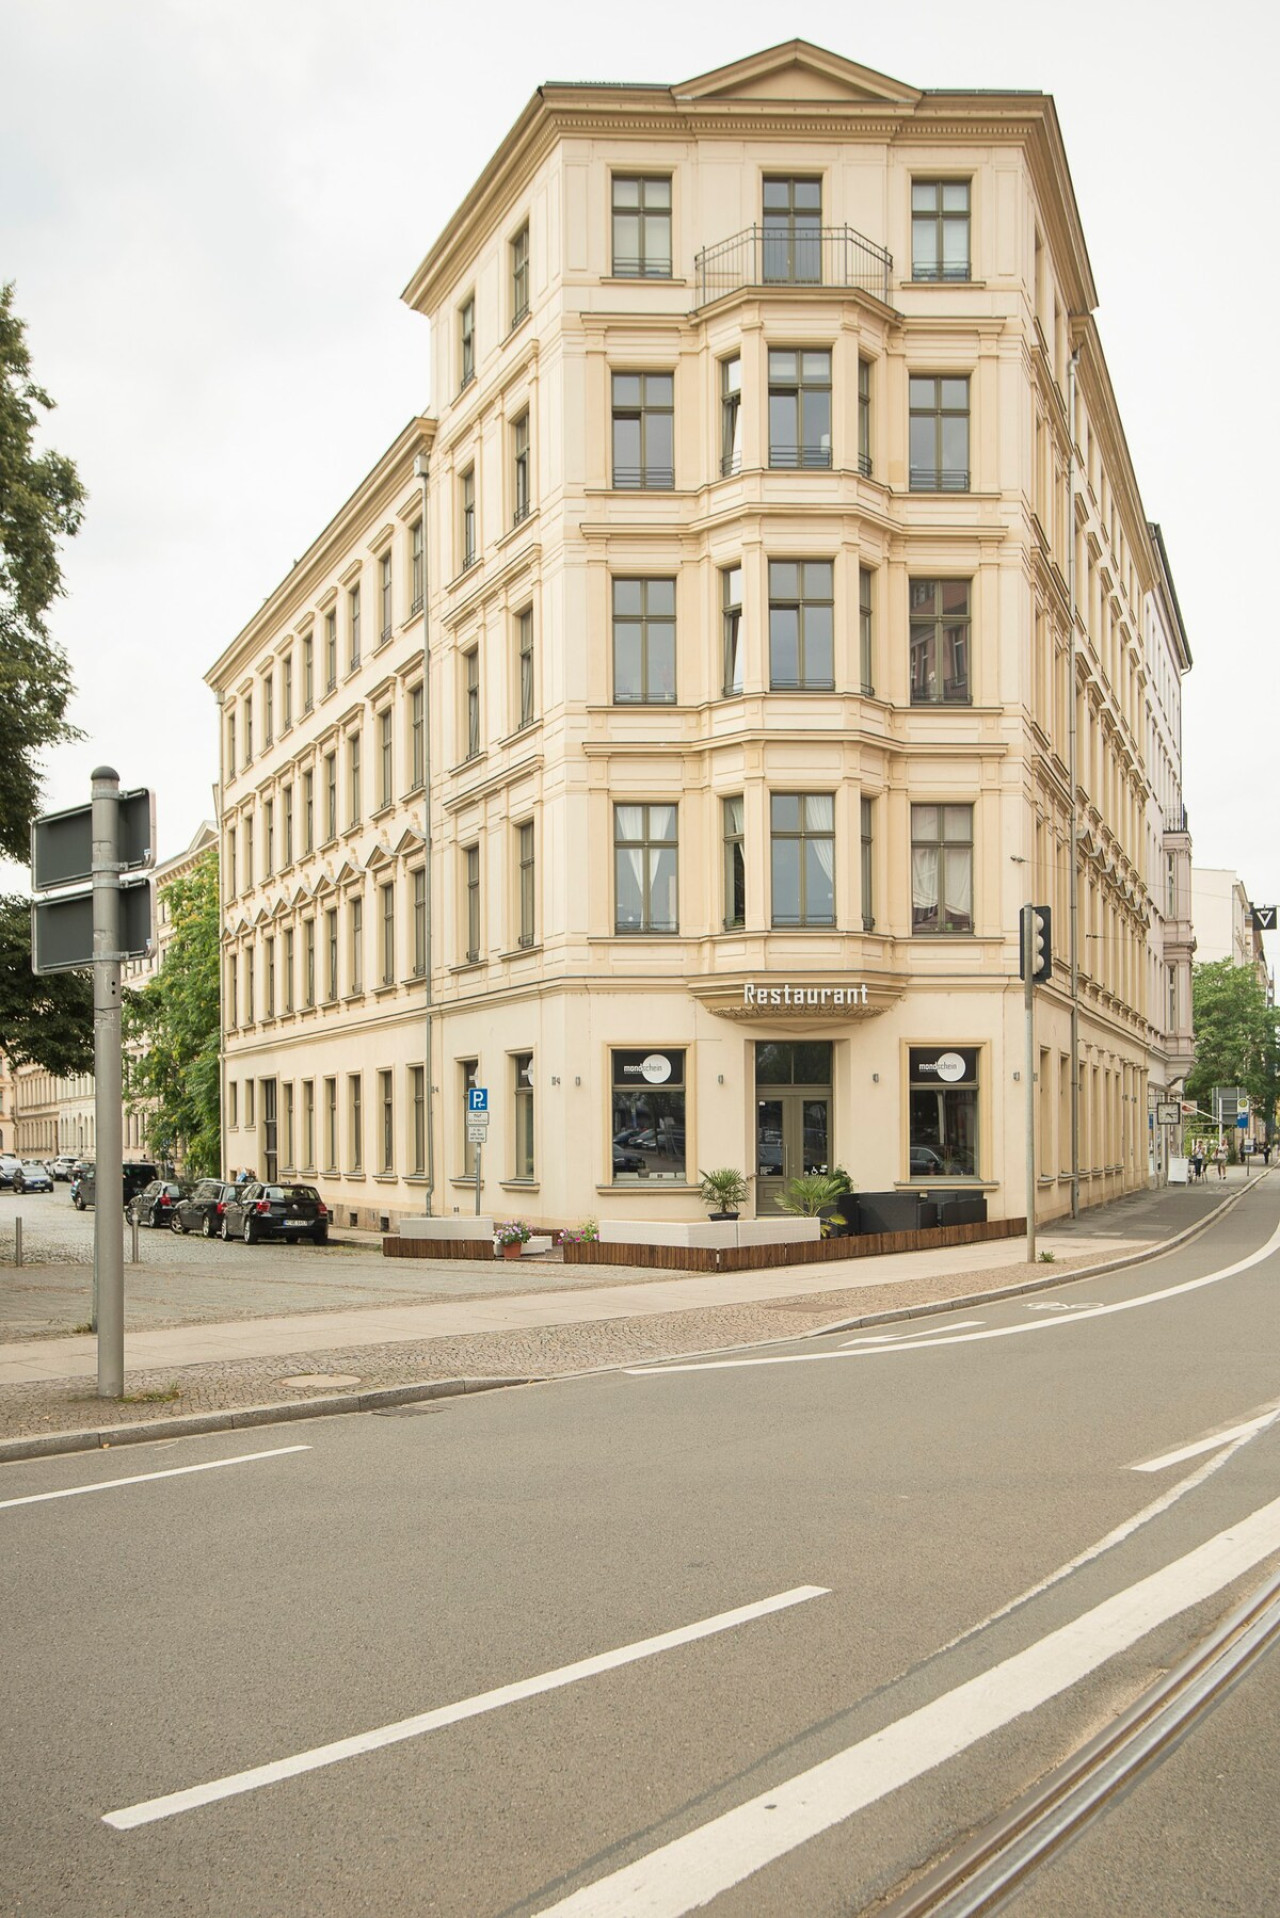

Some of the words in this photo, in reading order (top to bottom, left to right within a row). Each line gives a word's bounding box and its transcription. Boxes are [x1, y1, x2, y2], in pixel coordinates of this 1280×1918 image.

[744, 984, 868, 1004] Restaurant
[623, 1063, 663, 1072] mondschein
[918, 1061, 957, 1070] mondschein
[473, 1091, 484, 1108] P
